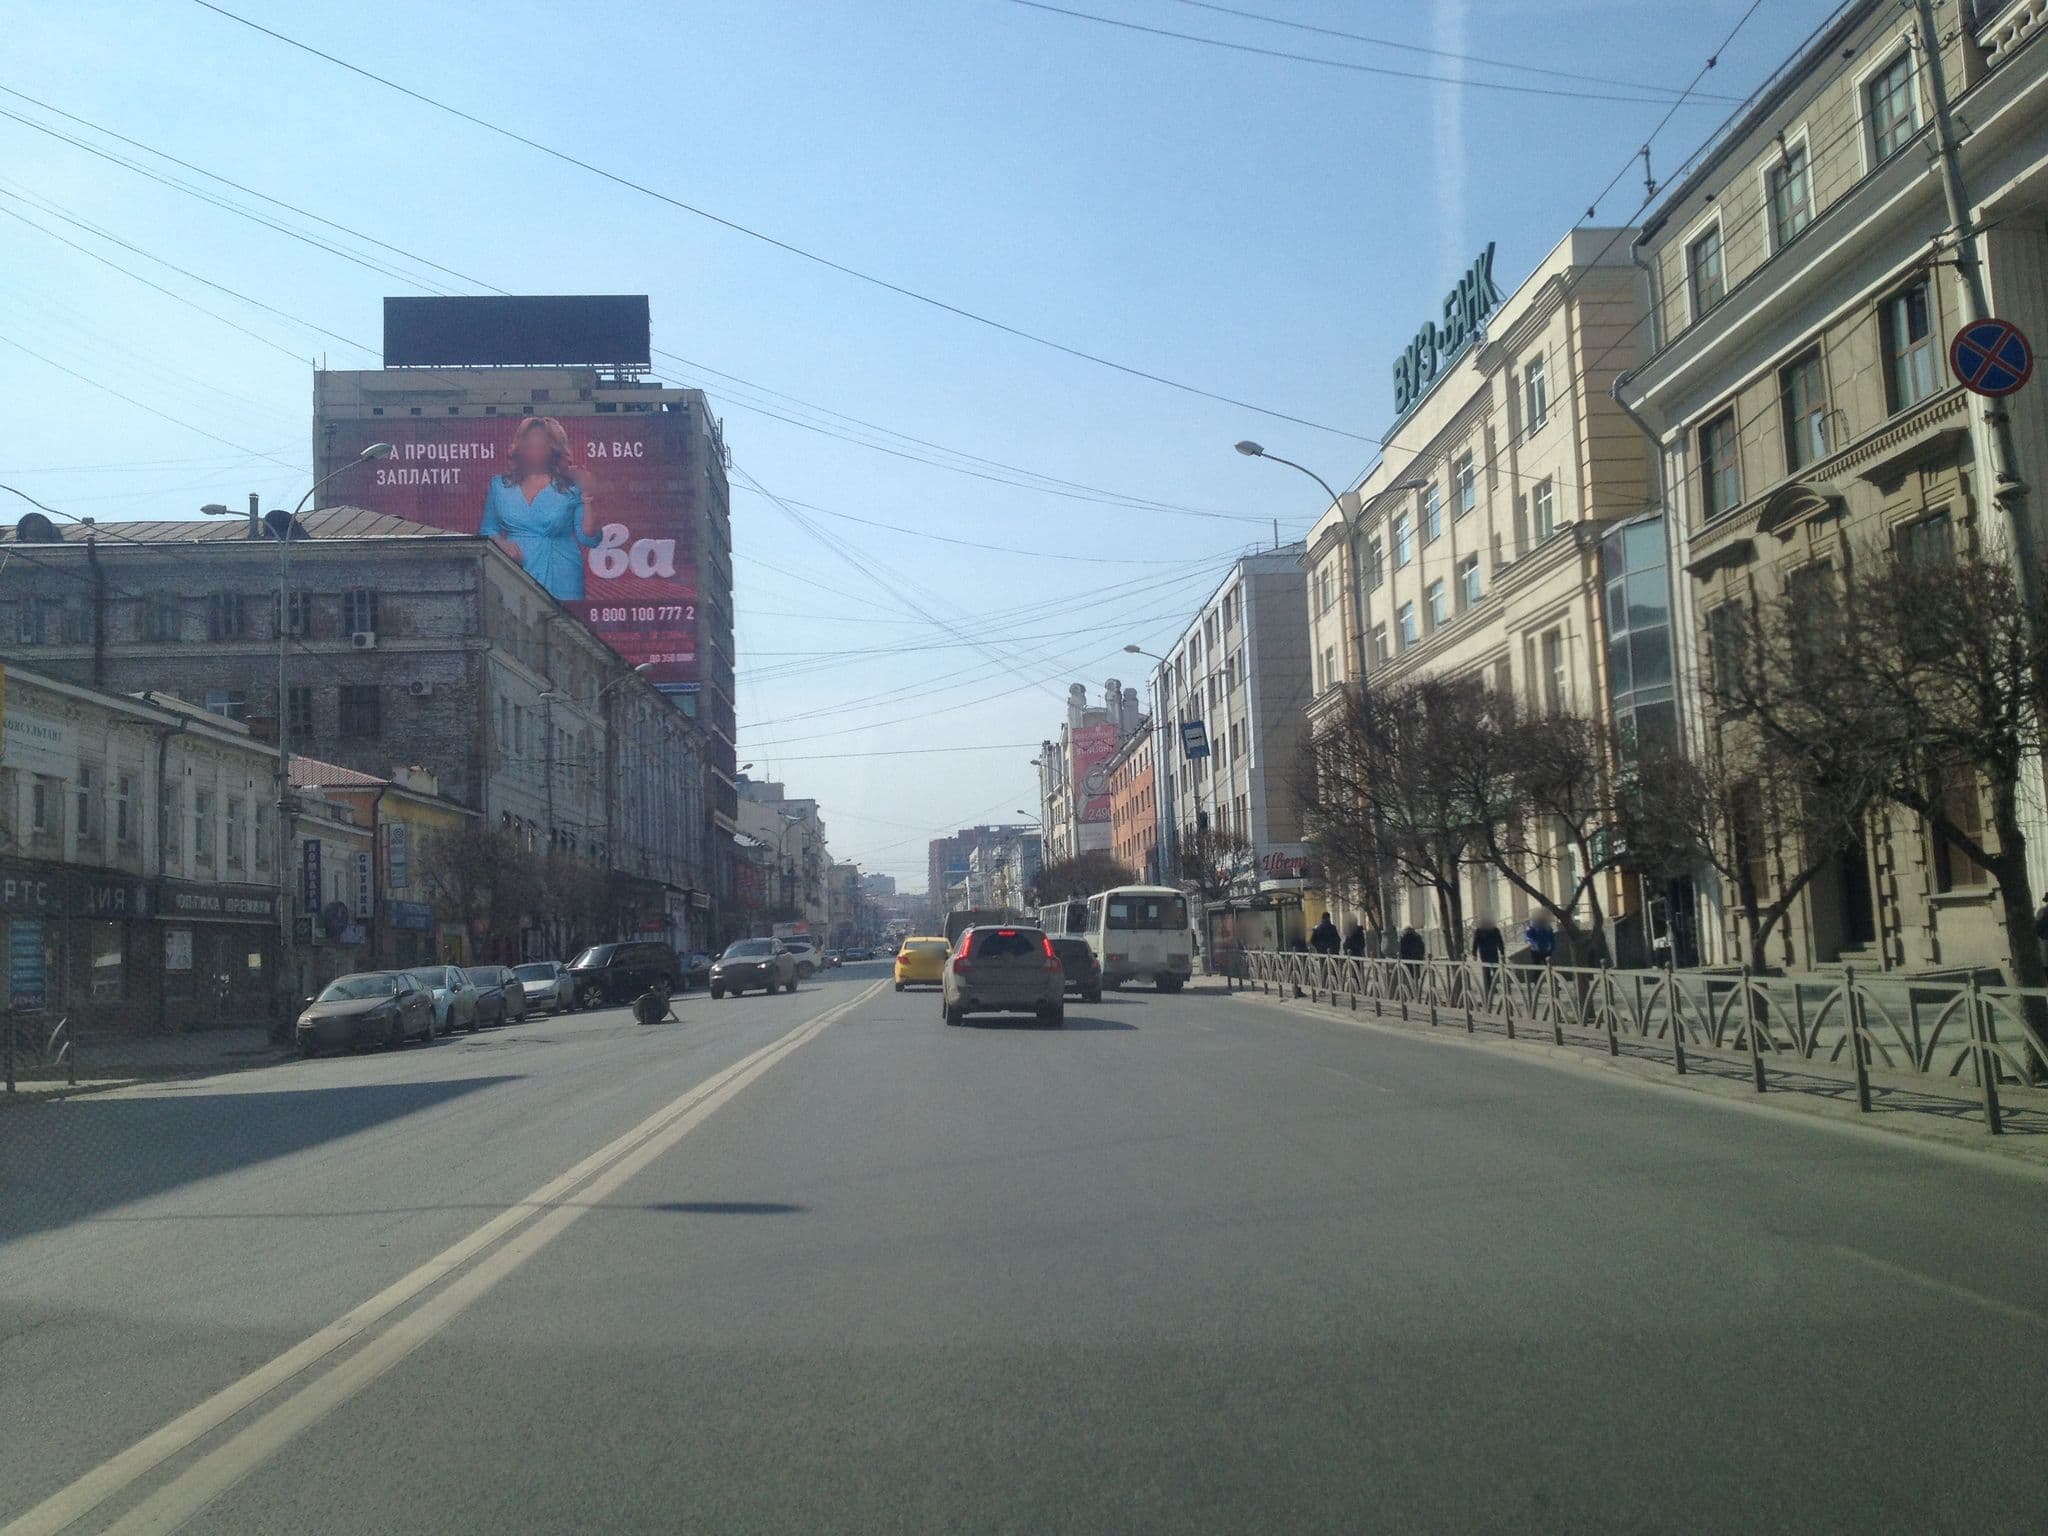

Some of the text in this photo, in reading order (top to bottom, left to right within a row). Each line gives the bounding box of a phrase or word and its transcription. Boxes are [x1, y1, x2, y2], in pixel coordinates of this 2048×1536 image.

[405, 443, 494, 461] ПРОЦЕНТЫ
[587, 442, 643, 458] ЗА ВАС
[376, 468, 461, 485] ЗАПЛАТИТ
[590, 606, 695, 622] 8 800 100 777 2
